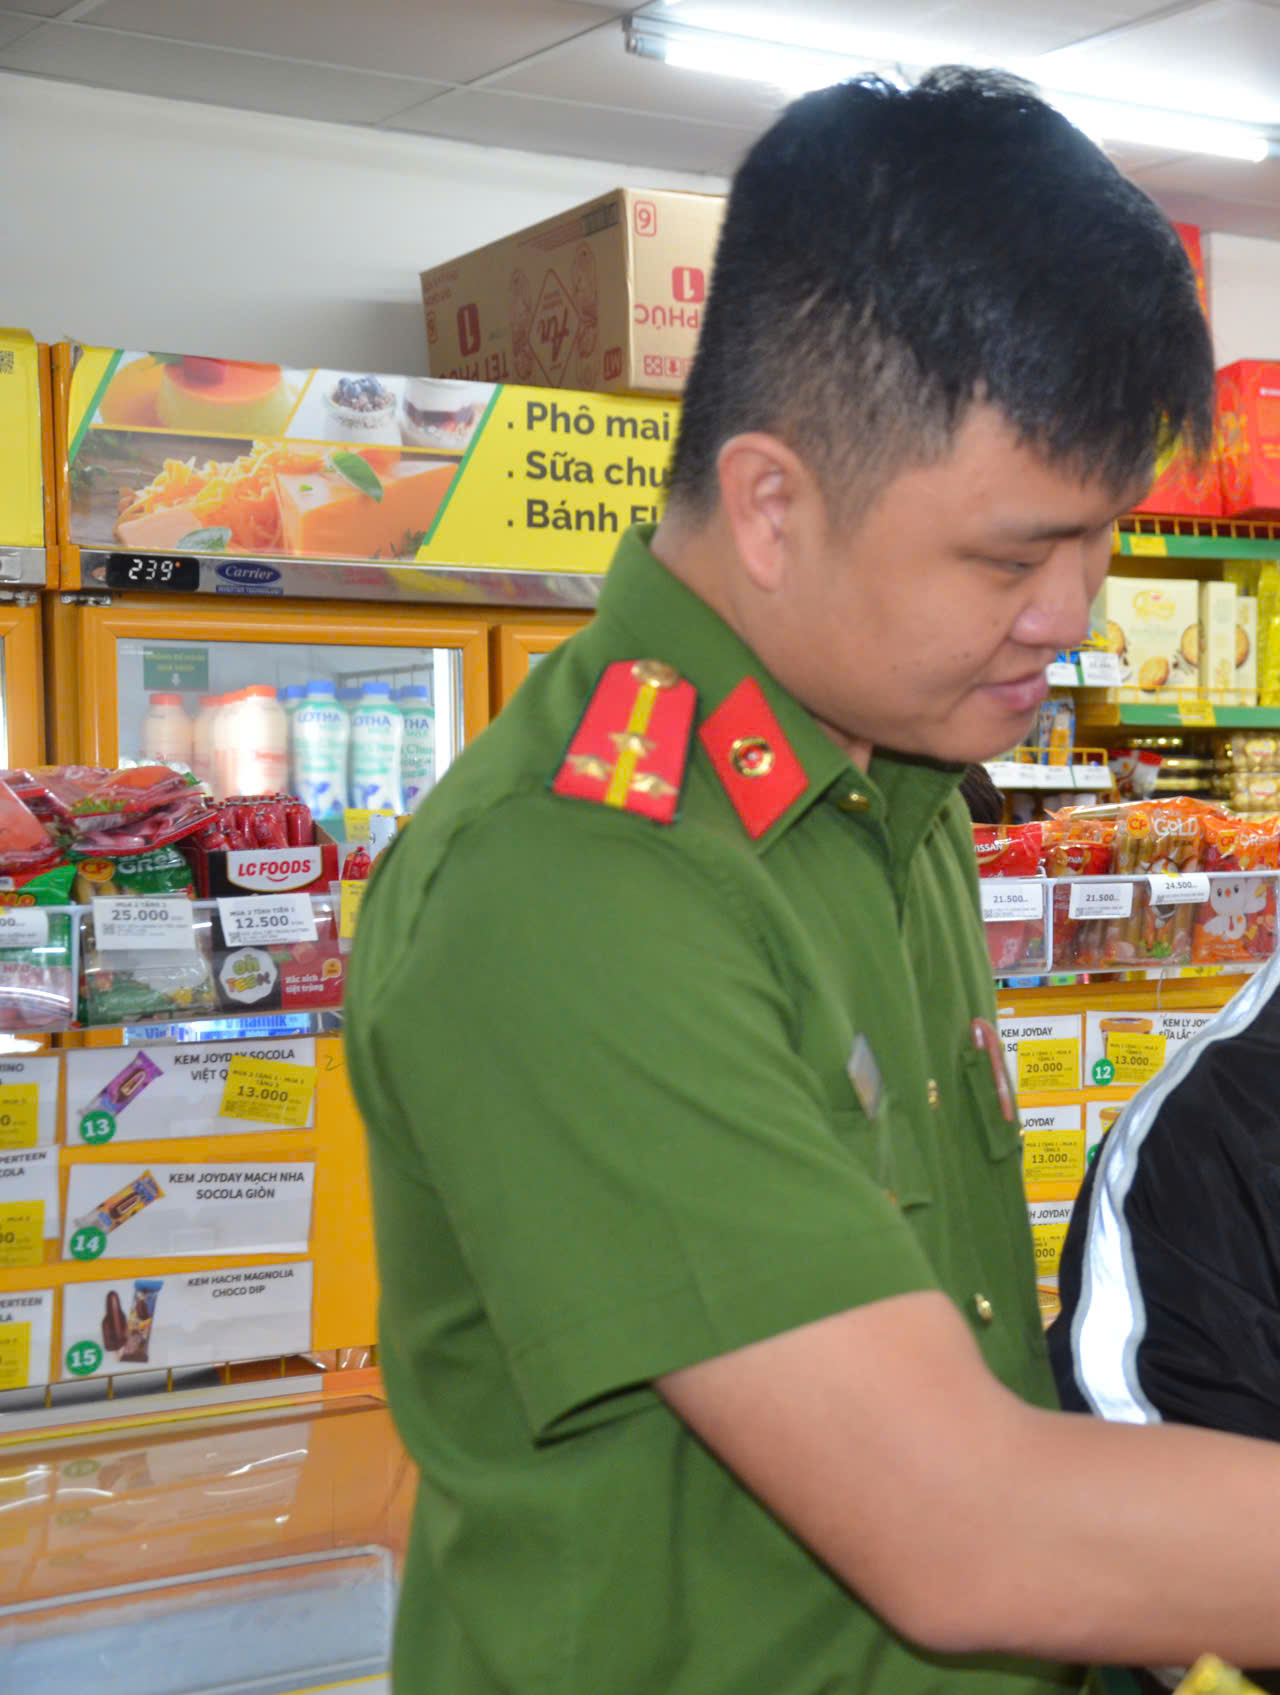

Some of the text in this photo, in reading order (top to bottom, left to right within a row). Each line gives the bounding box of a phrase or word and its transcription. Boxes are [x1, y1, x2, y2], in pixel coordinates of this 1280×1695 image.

[633, 304, 699, 331] PHÚC
[526, 401, 669, 441] Phô mai
[526, 450, 594, 484] Sữa
[526, 498, 618, 533] Bánh
[225, 565, 274, 581] Carrier
[238, 859, 312, 877] LC FOODS
[1165, 882, 1192, 890] 24.500
[993, 894, 1023, 903] 21.500
[1085, 894, 1114, 902] 21.500
[111, 910, 168, 921] 25.000
[235, 915, 289, 929] 12.500
[1162, 1018, 1180, 1027] KEM
[1182, 1018, 1191, 1027] LY
[1001, 1027, 1053, 1038] KEM JOYDAY
[174, 1055, 199, 1065] KEM
[250, 1050, 295, 1060] SOCOLA
[1115, 1055, 1150, 1066] 13.000
[1026, 1062, 1063, 1073] 20.000
[1095, 1066, 1112, 1079] 12
[191, 1068, 217, 1083] VIỆT
[238, 1086, 289, 1102] 13.000
[84, 1118, 110, 1137] 13
[1024, 1118, 1055, 1128] JOYDAY
[1032, 1154, 1068, 1164] 13.000
[169, 1172, 305, 1185] KEM JOYDAY MẠCH NHA
[196, 1186, 275, 1200] SOCOLA GIÒN
[1037, 1209, 1071, 1219] JOYDAY
[74, 1235, 99, 1253] 14
[187, 1269, 294, 1287] KEM HACHI MAGNOLIA
[212, 1285, 266, 1298] CHOCO DIP
[71, 1348, 97, 1367] 15
